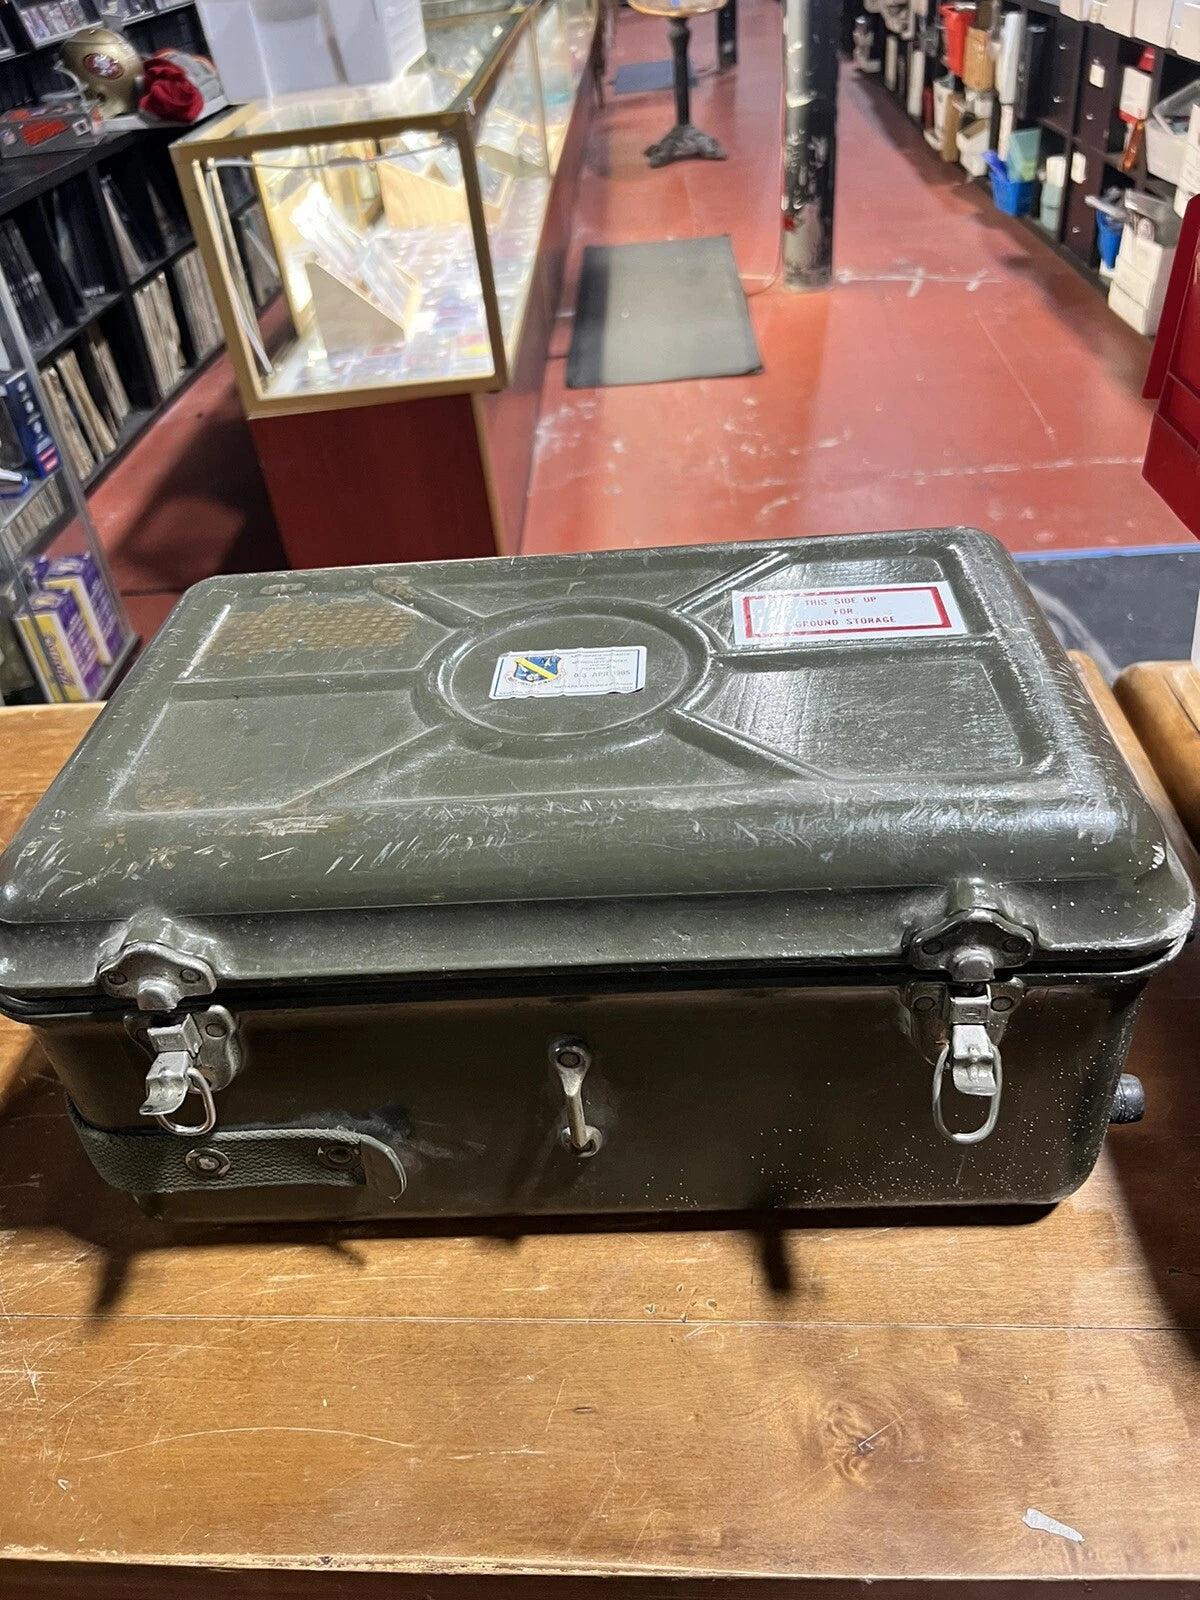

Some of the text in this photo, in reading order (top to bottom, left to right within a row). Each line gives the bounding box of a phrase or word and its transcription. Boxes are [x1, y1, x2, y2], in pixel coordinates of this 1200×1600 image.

[834, 597, 857, 605] SIDE
[795, 616, 897, 628] GROUND STORAGE
